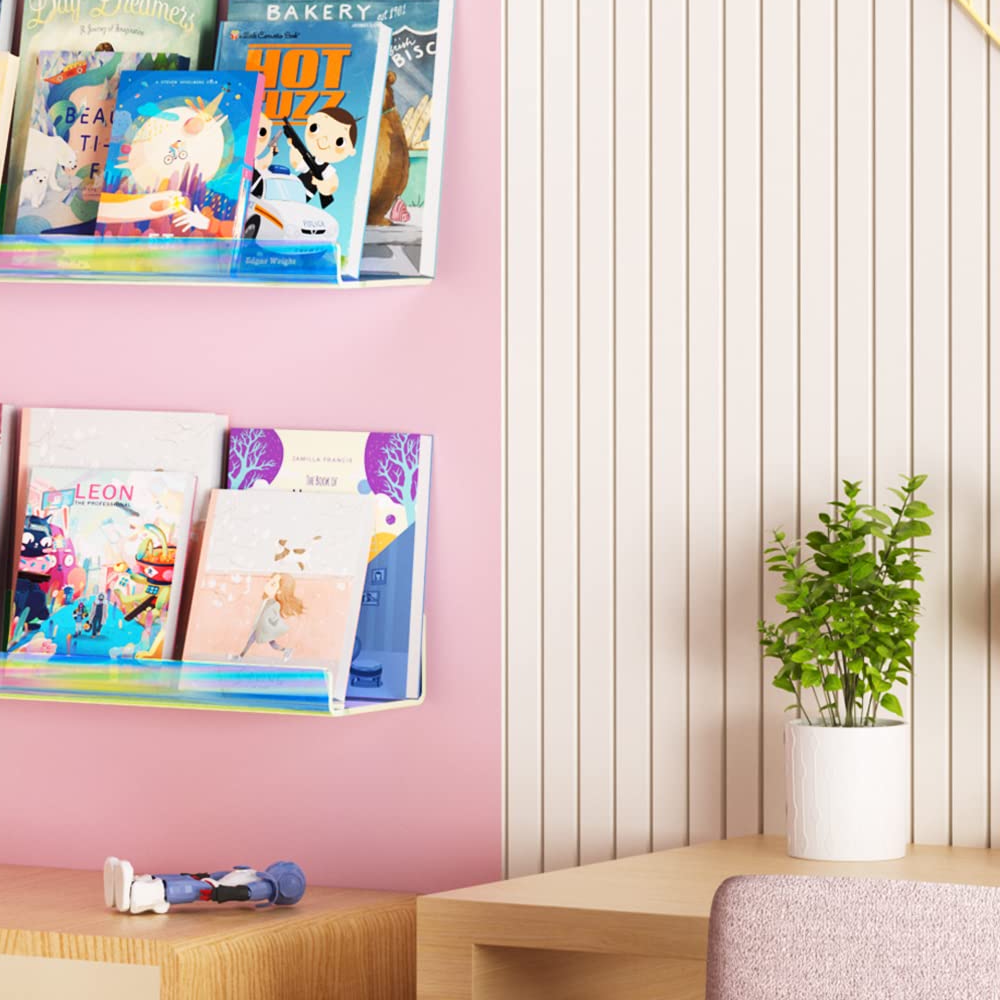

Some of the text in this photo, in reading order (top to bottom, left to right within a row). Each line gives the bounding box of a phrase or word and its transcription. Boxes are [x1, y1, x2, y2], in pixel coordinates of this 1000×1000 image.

[266, 3, 371, 21] BAKERY
[392, 41, 437, 68] BISC
[245, 50, 351, 89] HOT
[75, 484, 134, 500] LEON
